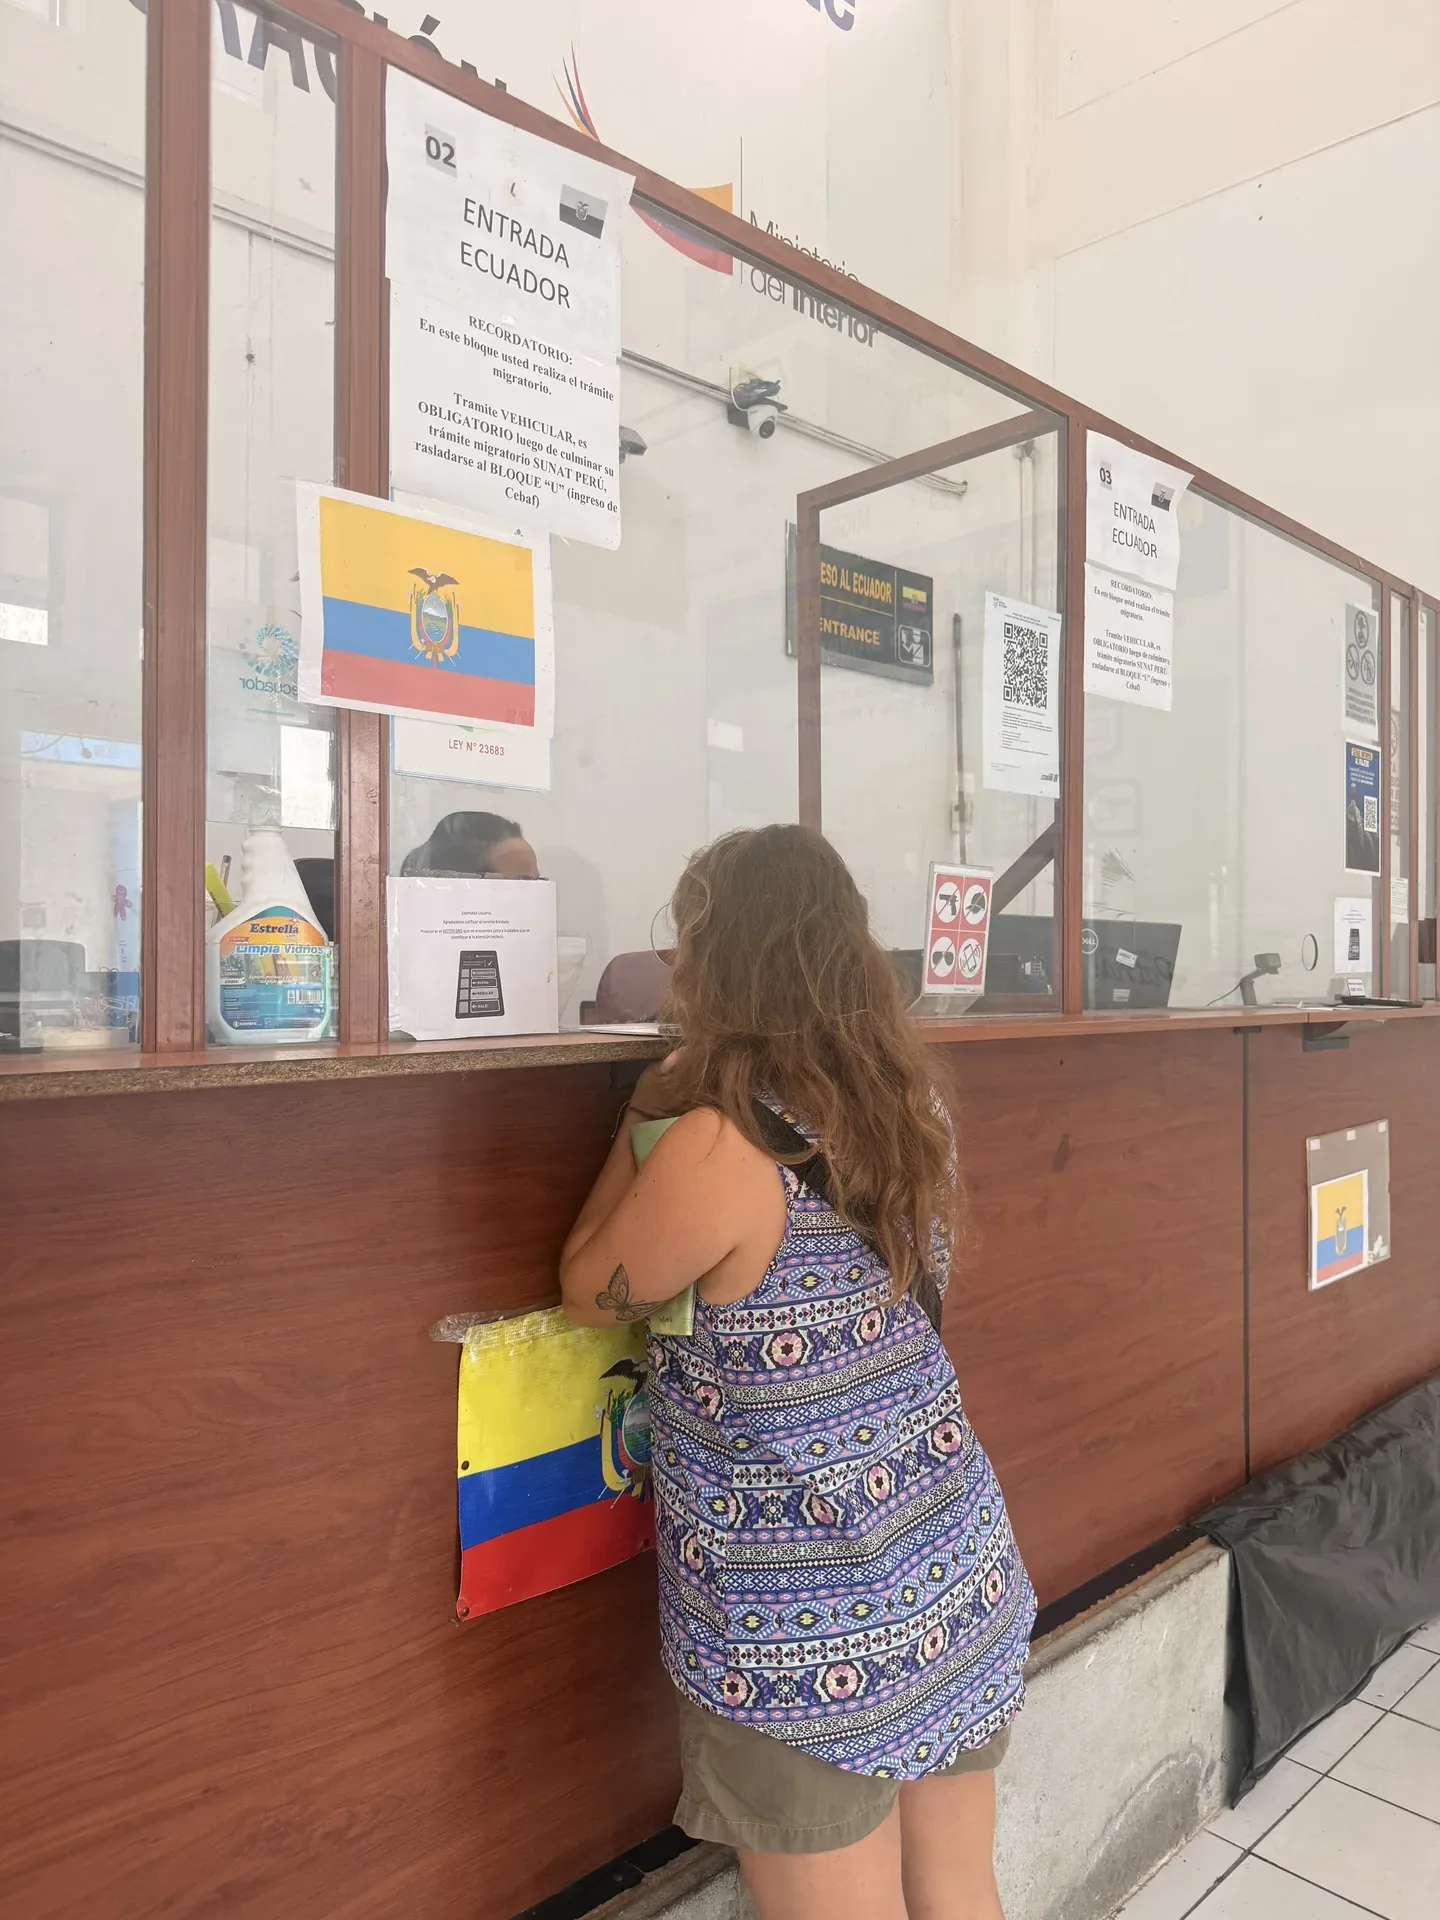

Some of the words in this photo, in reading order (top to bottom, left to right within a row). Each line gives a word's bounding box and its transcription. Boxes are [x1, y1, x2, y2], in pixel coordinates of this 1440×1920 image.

[425, 135, 457, 169] 02
[464, 197, 570, 269] ENTRADA
[460, 241, 570, 309] ECUADOR
[468, 315, 573, 365] RECORDATORIO:
[419, 317, 435, 334] En
[439, 327, 461, 343] este
[464, 334, 499, 358] bloque
[501, 353, 529, 370] usted
[532, 363, 566, 383] realiza
[569, 376, 577, 387] el
[579, 380, 614, 401] trámite
[492, 366, 552, 395] migratorio.
[453, 392, 498, 418] Tramite
[500, 408, 576, 446] VEHICULAR,
[578, 438, 588, 449] es
[418, 401, 513, 441] OBLIGATORIO
[516, 432, 544, 452] luego
[546, 443, 558, 456] de
[560, 449, 603, 472] culminar
[604, 465, 614, 477] su
[428, 424, 470, 447] trámite
[473, 440, 530, 466] migratorio
[533, 457, 573, 479] SUNAT
[575, 472, 607, 493] PERÚ,
[413, 441, 474, 467] rasladarse
[477, 459, 487, 472] al
[490, 462, 542, 489] BLOQUE
[567, 487, 605, 510] (ingreso
[607, 500, 618, 513] de
[1099, 467, 1112, 485] 03
[505, 486, 540, 509] Cebaf)
[1114, 501, 1156, 534] ENTRADA
[1112, 528, 1158, 558] ECUADOR
[839, 569, 850, 591] AL
[853, 573, 892, 603] ECUADOR
[1110, 580, 1153, 600] RECORDATORIO:
[1109, 592, 1123, 604] bloque
[1124, 599, 1135, 607] usted
[1136, 603, 1151, 612] realiza
[1093, 637, 1129, 654] OBLIGATORIO
[1120, 668, 1142, 680] BLOQUE
[449, 739, 464, 750] LEY
[466, 741, 477, 752] N°
[479, 743, 505, 756] 23683
[249, 923, 299, 934] Estrella
[236, 944, 280, 955] Limpia
[284, 944, 325, 955] Vidrios
